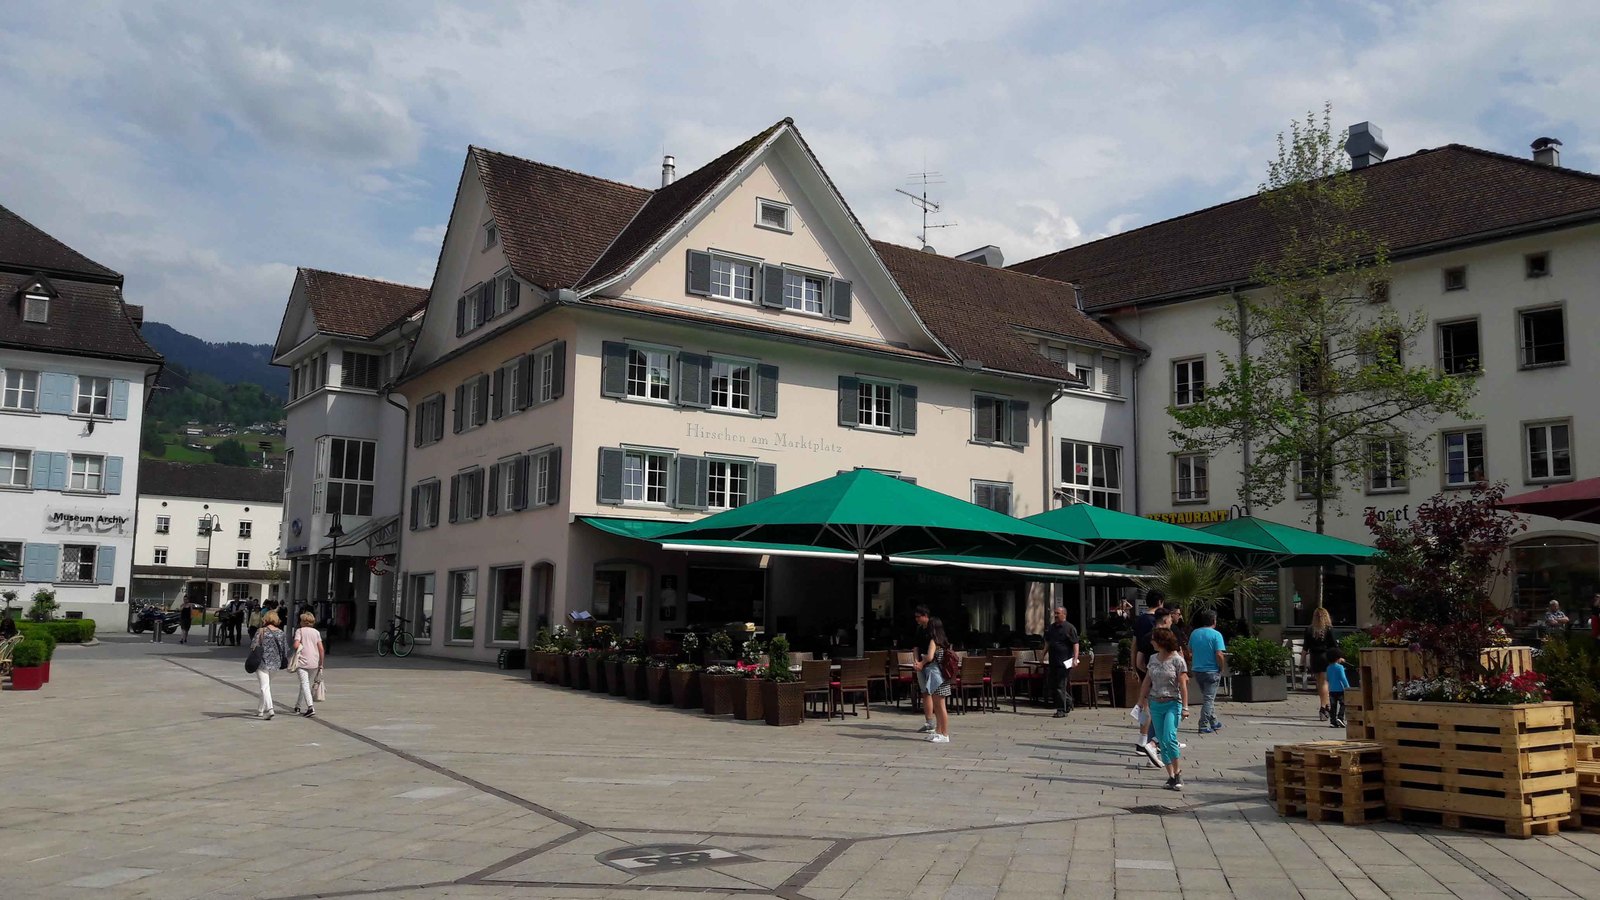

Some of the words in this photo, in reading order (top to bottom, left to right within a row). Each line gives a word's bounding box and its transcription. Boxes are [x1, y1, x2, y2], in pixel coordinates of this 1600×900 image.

[686, 422, 746, 443] Hirschen
[751, 435, 769, 445] am
[774, 432, 843, 453] Marktplatz
[53, 512, 95, 523] Museum
[97, 515, 127, 524] Archiv
